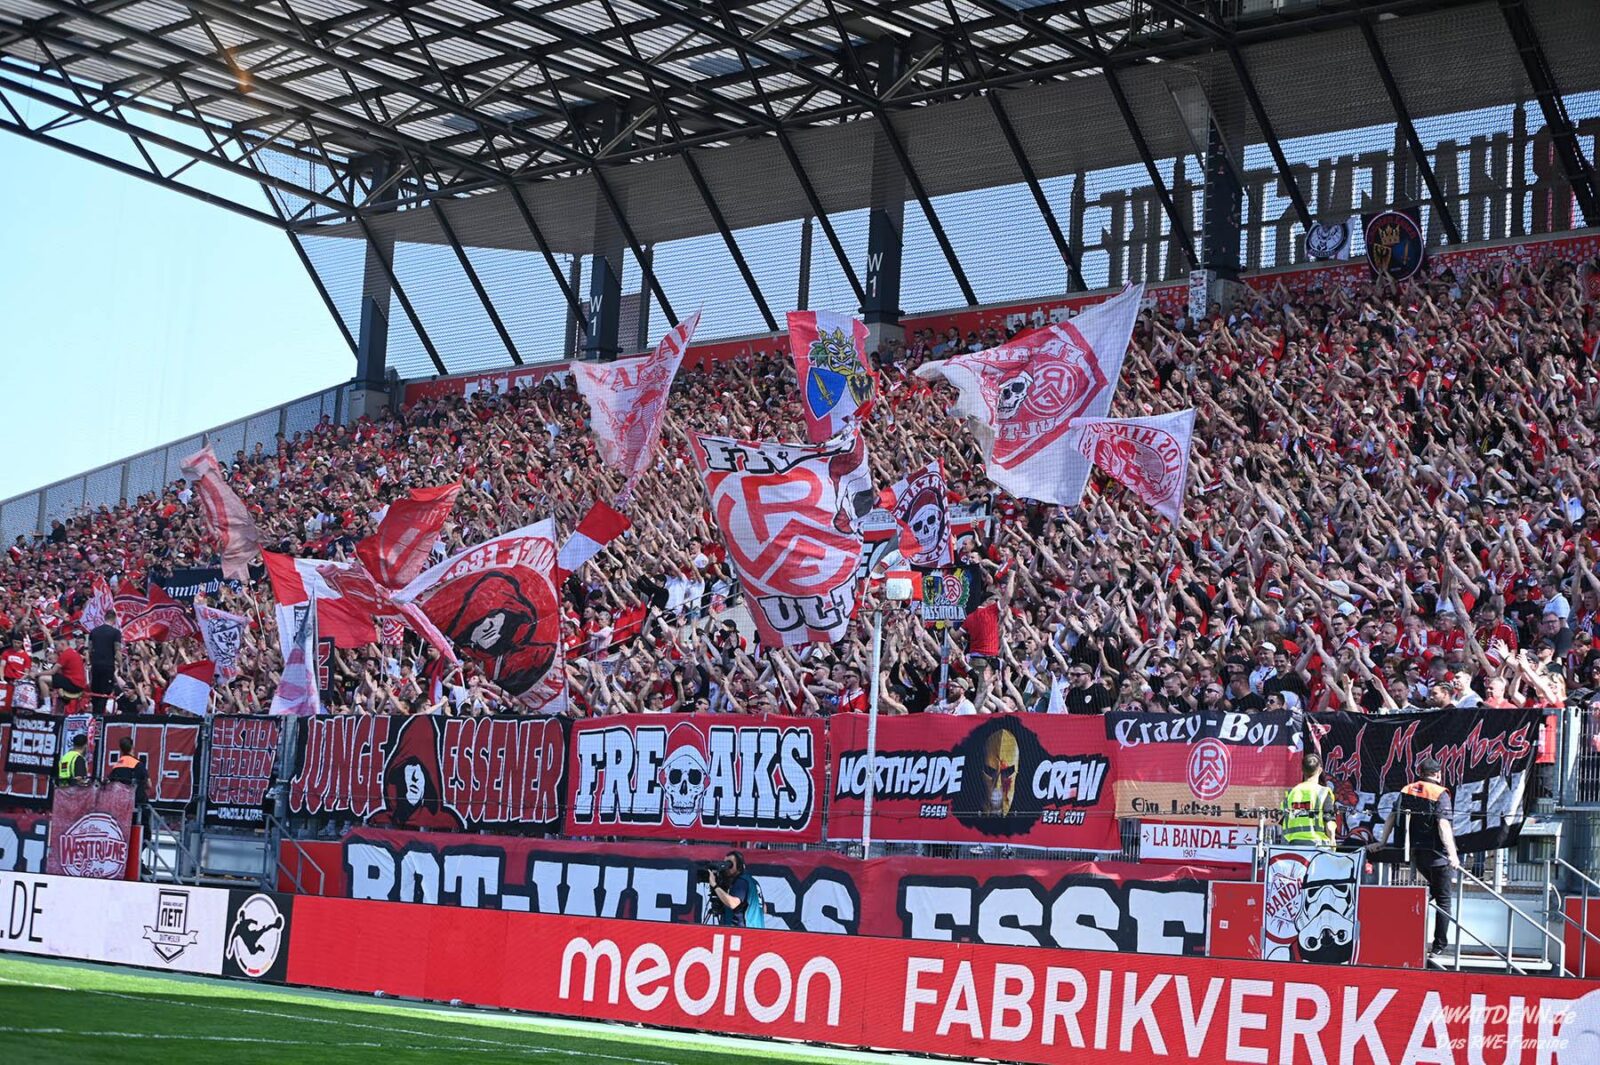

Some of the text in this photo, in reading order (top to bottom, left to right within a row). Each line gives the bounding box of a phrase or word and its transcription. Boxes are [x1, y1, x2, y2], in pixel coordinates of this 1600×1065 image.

[868, 252, 883, 298] W 1
[590, 294, 603, 336] W 1
[11, 730, 57, 755] ACAB
[212, 717, 279, 750] SEKTION
[288, 713, 566, 826] JUNGE ESSENER
[574, 727, 814, 832] FREAKS
[837, 754, 965, 797] NORTHSIDE
[1032, 758, 1106, 800] CREW
[920, 804, 948, 818] ESSEN
[1042, 810, 1086, 824] EST. 2011
[1153, 827, 1238, 849] LA BANDA E
[1182, 849, 1198, 858] 1907
[160, 907, 183, 928] NETT
[558, 934, 841, 1027] medion
